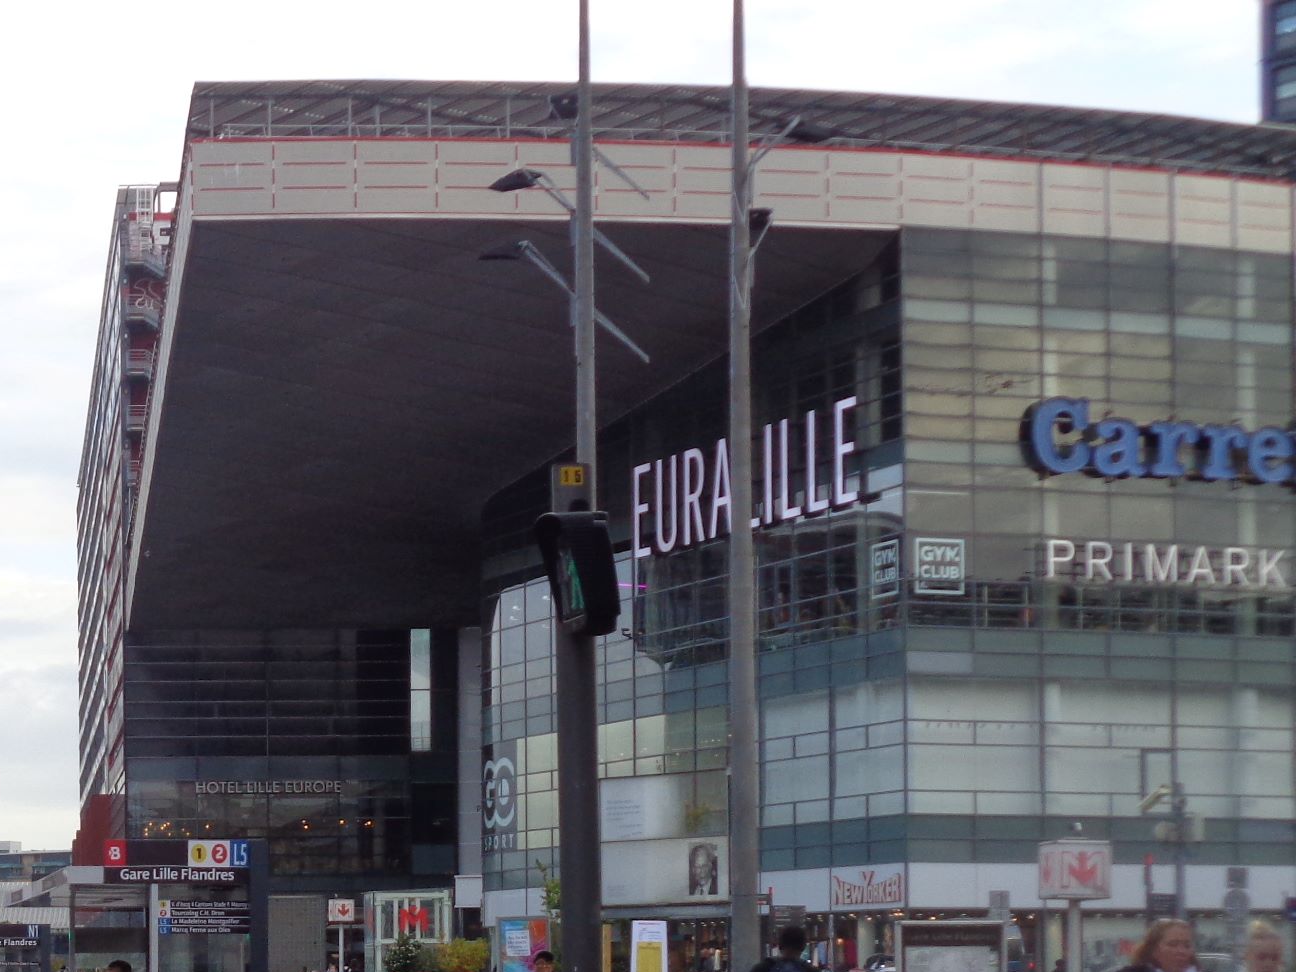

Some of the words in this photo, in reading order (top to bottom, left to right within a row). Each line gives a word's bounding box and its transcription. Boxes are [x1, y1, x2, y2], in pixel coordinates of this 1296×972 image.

[633, 396, 858, 559] EURAILLE
[920, 565, 961, 579] CLUB
[1045, 540, 1287, 587] PRIMARK
[874, 566, 896, 583] CLUB
[196, 781, 241, 794] HOTEL
[247, 781, 280, 793] LILLE
[285, 780, 341, 793] EUROPE
[484, 757, 515, 829] GO
[484, 834, 514, 852] SPORT
[196, 848, 202, 859] 1
[215, 848, 224, 859] 2
[233, 843, 248, 866] L5
[120, 868, 150, 880] Gare
[153, 868, 179, 880] Lille
[181, 867, 235, 880] Flandres
[28, 924, 39, 938] N1
[4, 938, 37, 946] Flandres
